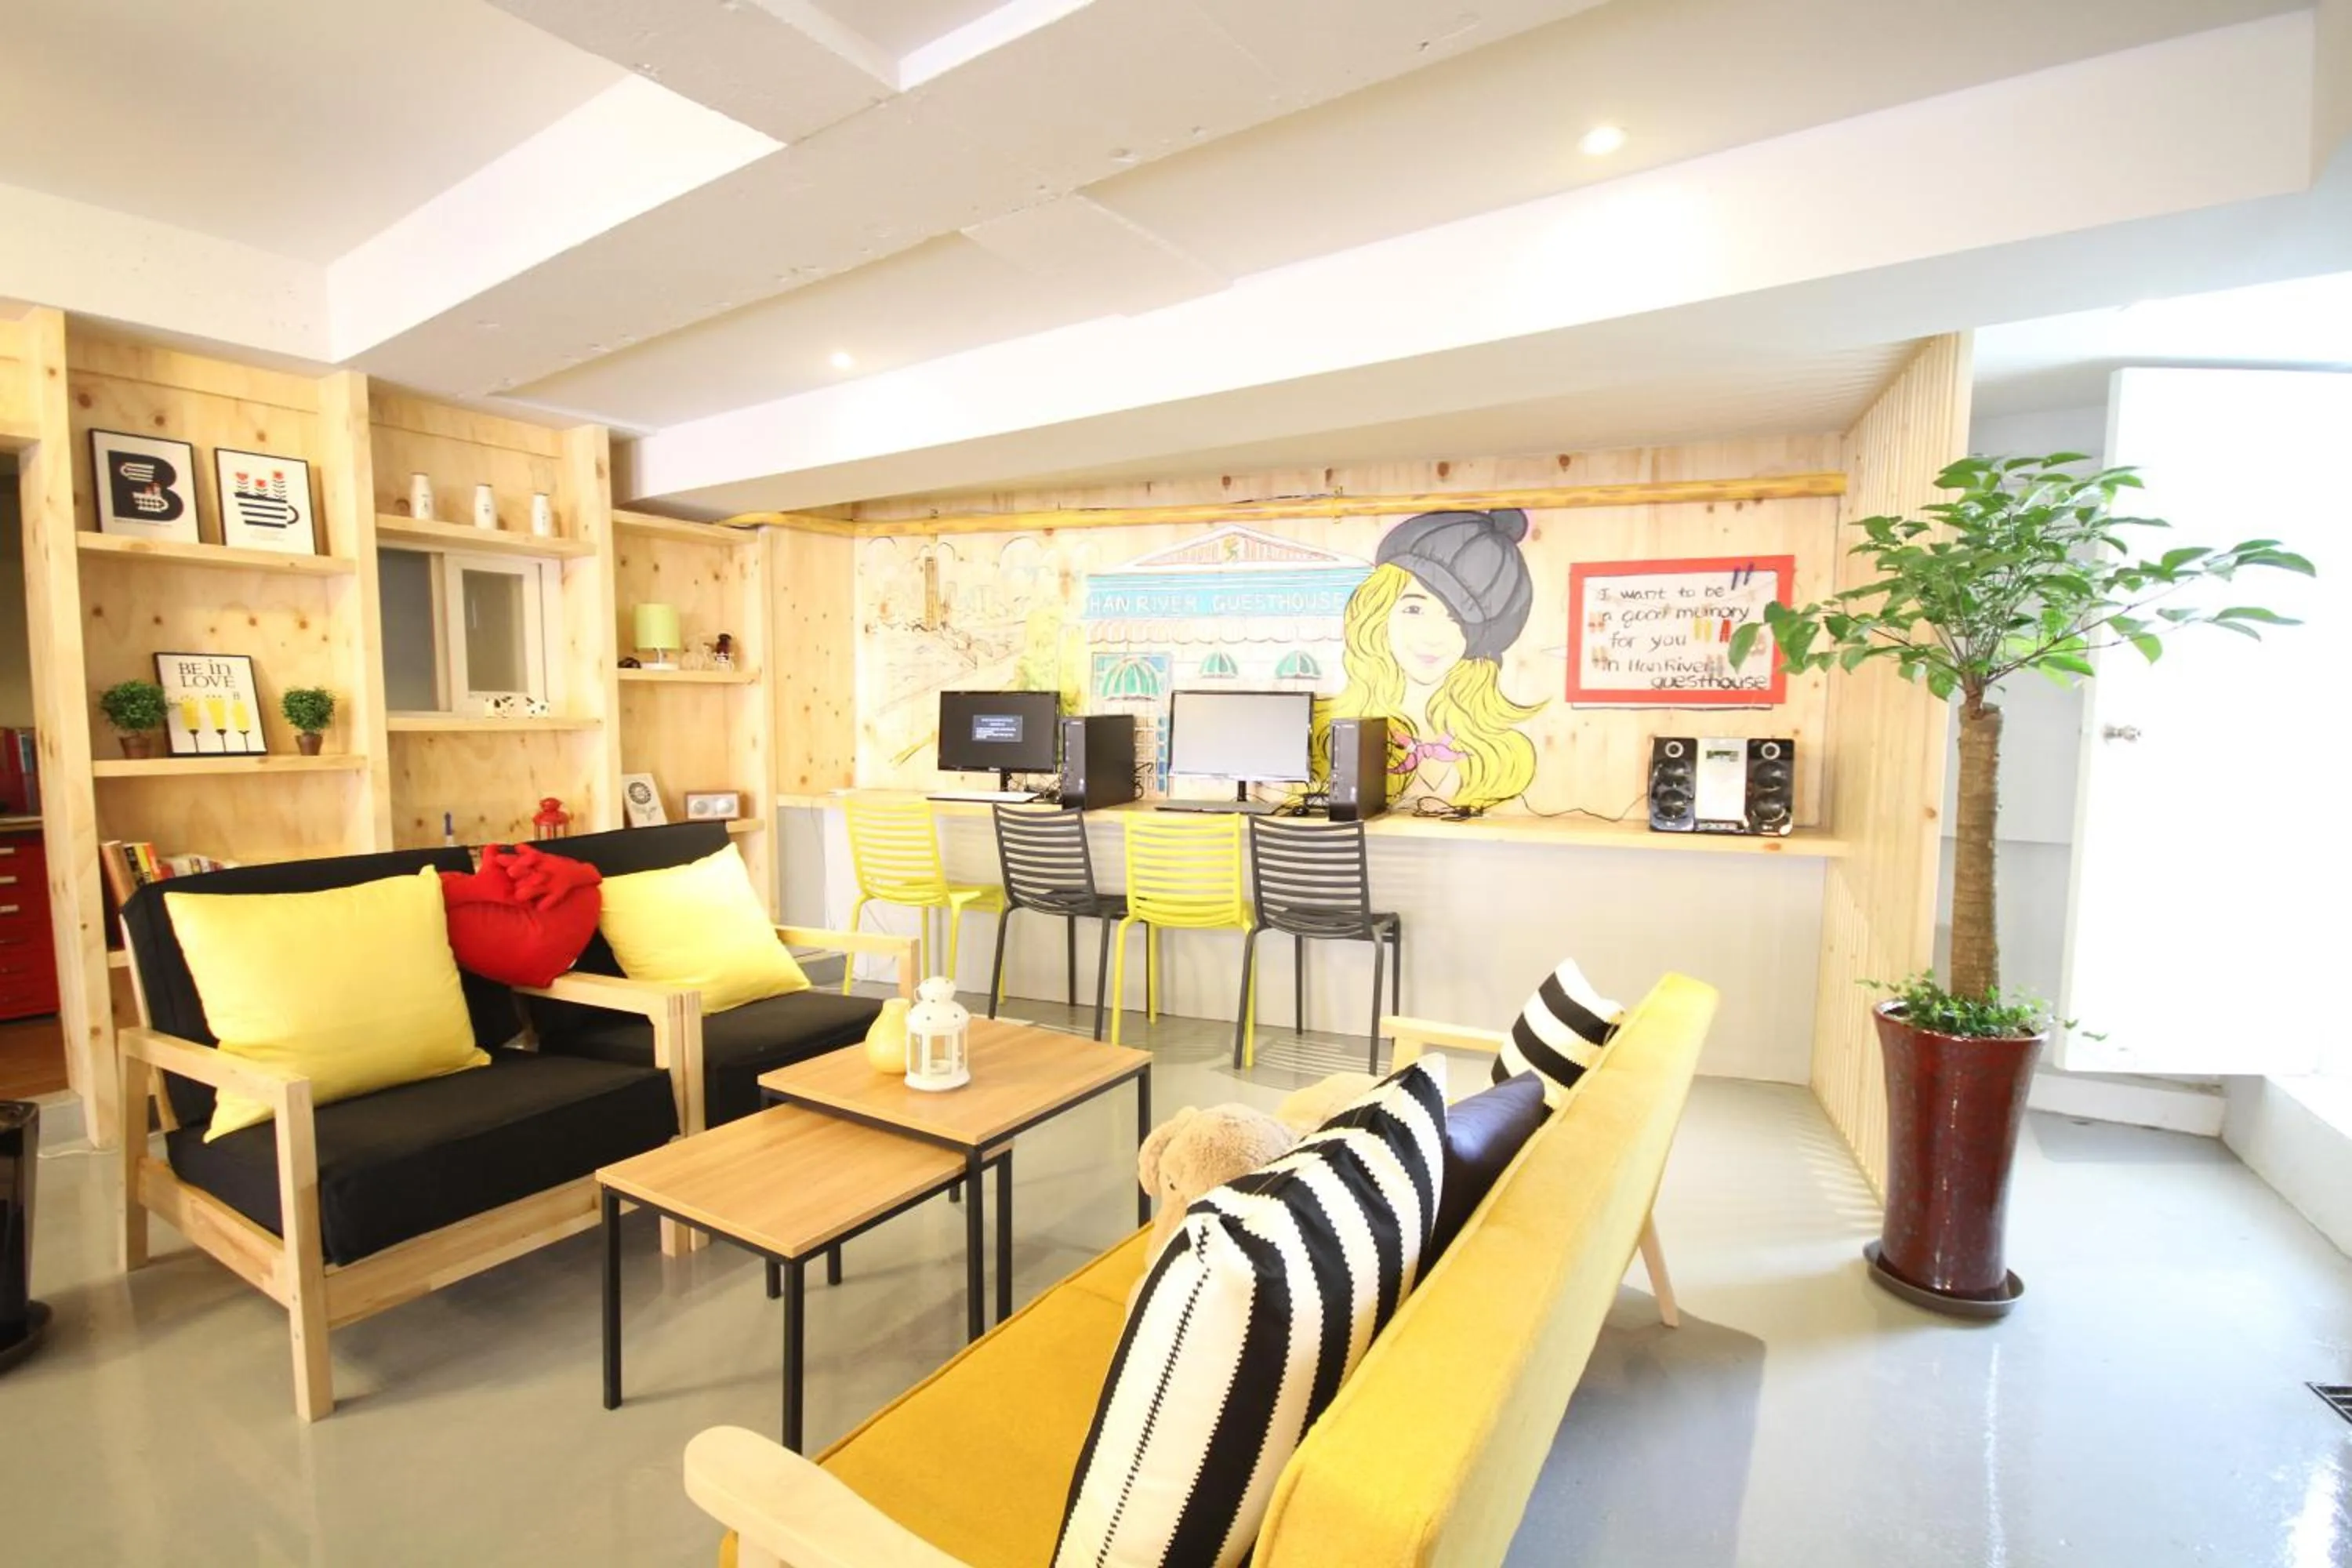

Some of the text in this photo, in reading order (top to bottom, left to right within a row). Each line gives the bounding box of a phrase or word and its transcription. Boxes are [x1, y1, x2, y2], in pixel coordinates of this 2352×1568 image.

[1213, 590, 1345, 613] GUESTHOUSE
[1600, 586, 1725, 601] I want to be
[1609, 630, 1687, 653] for you
[178, 659, 231, 676] BE in
[180, 675, 236, 688] LOVE
[1650, 674, 1767, 691] guesthouse
